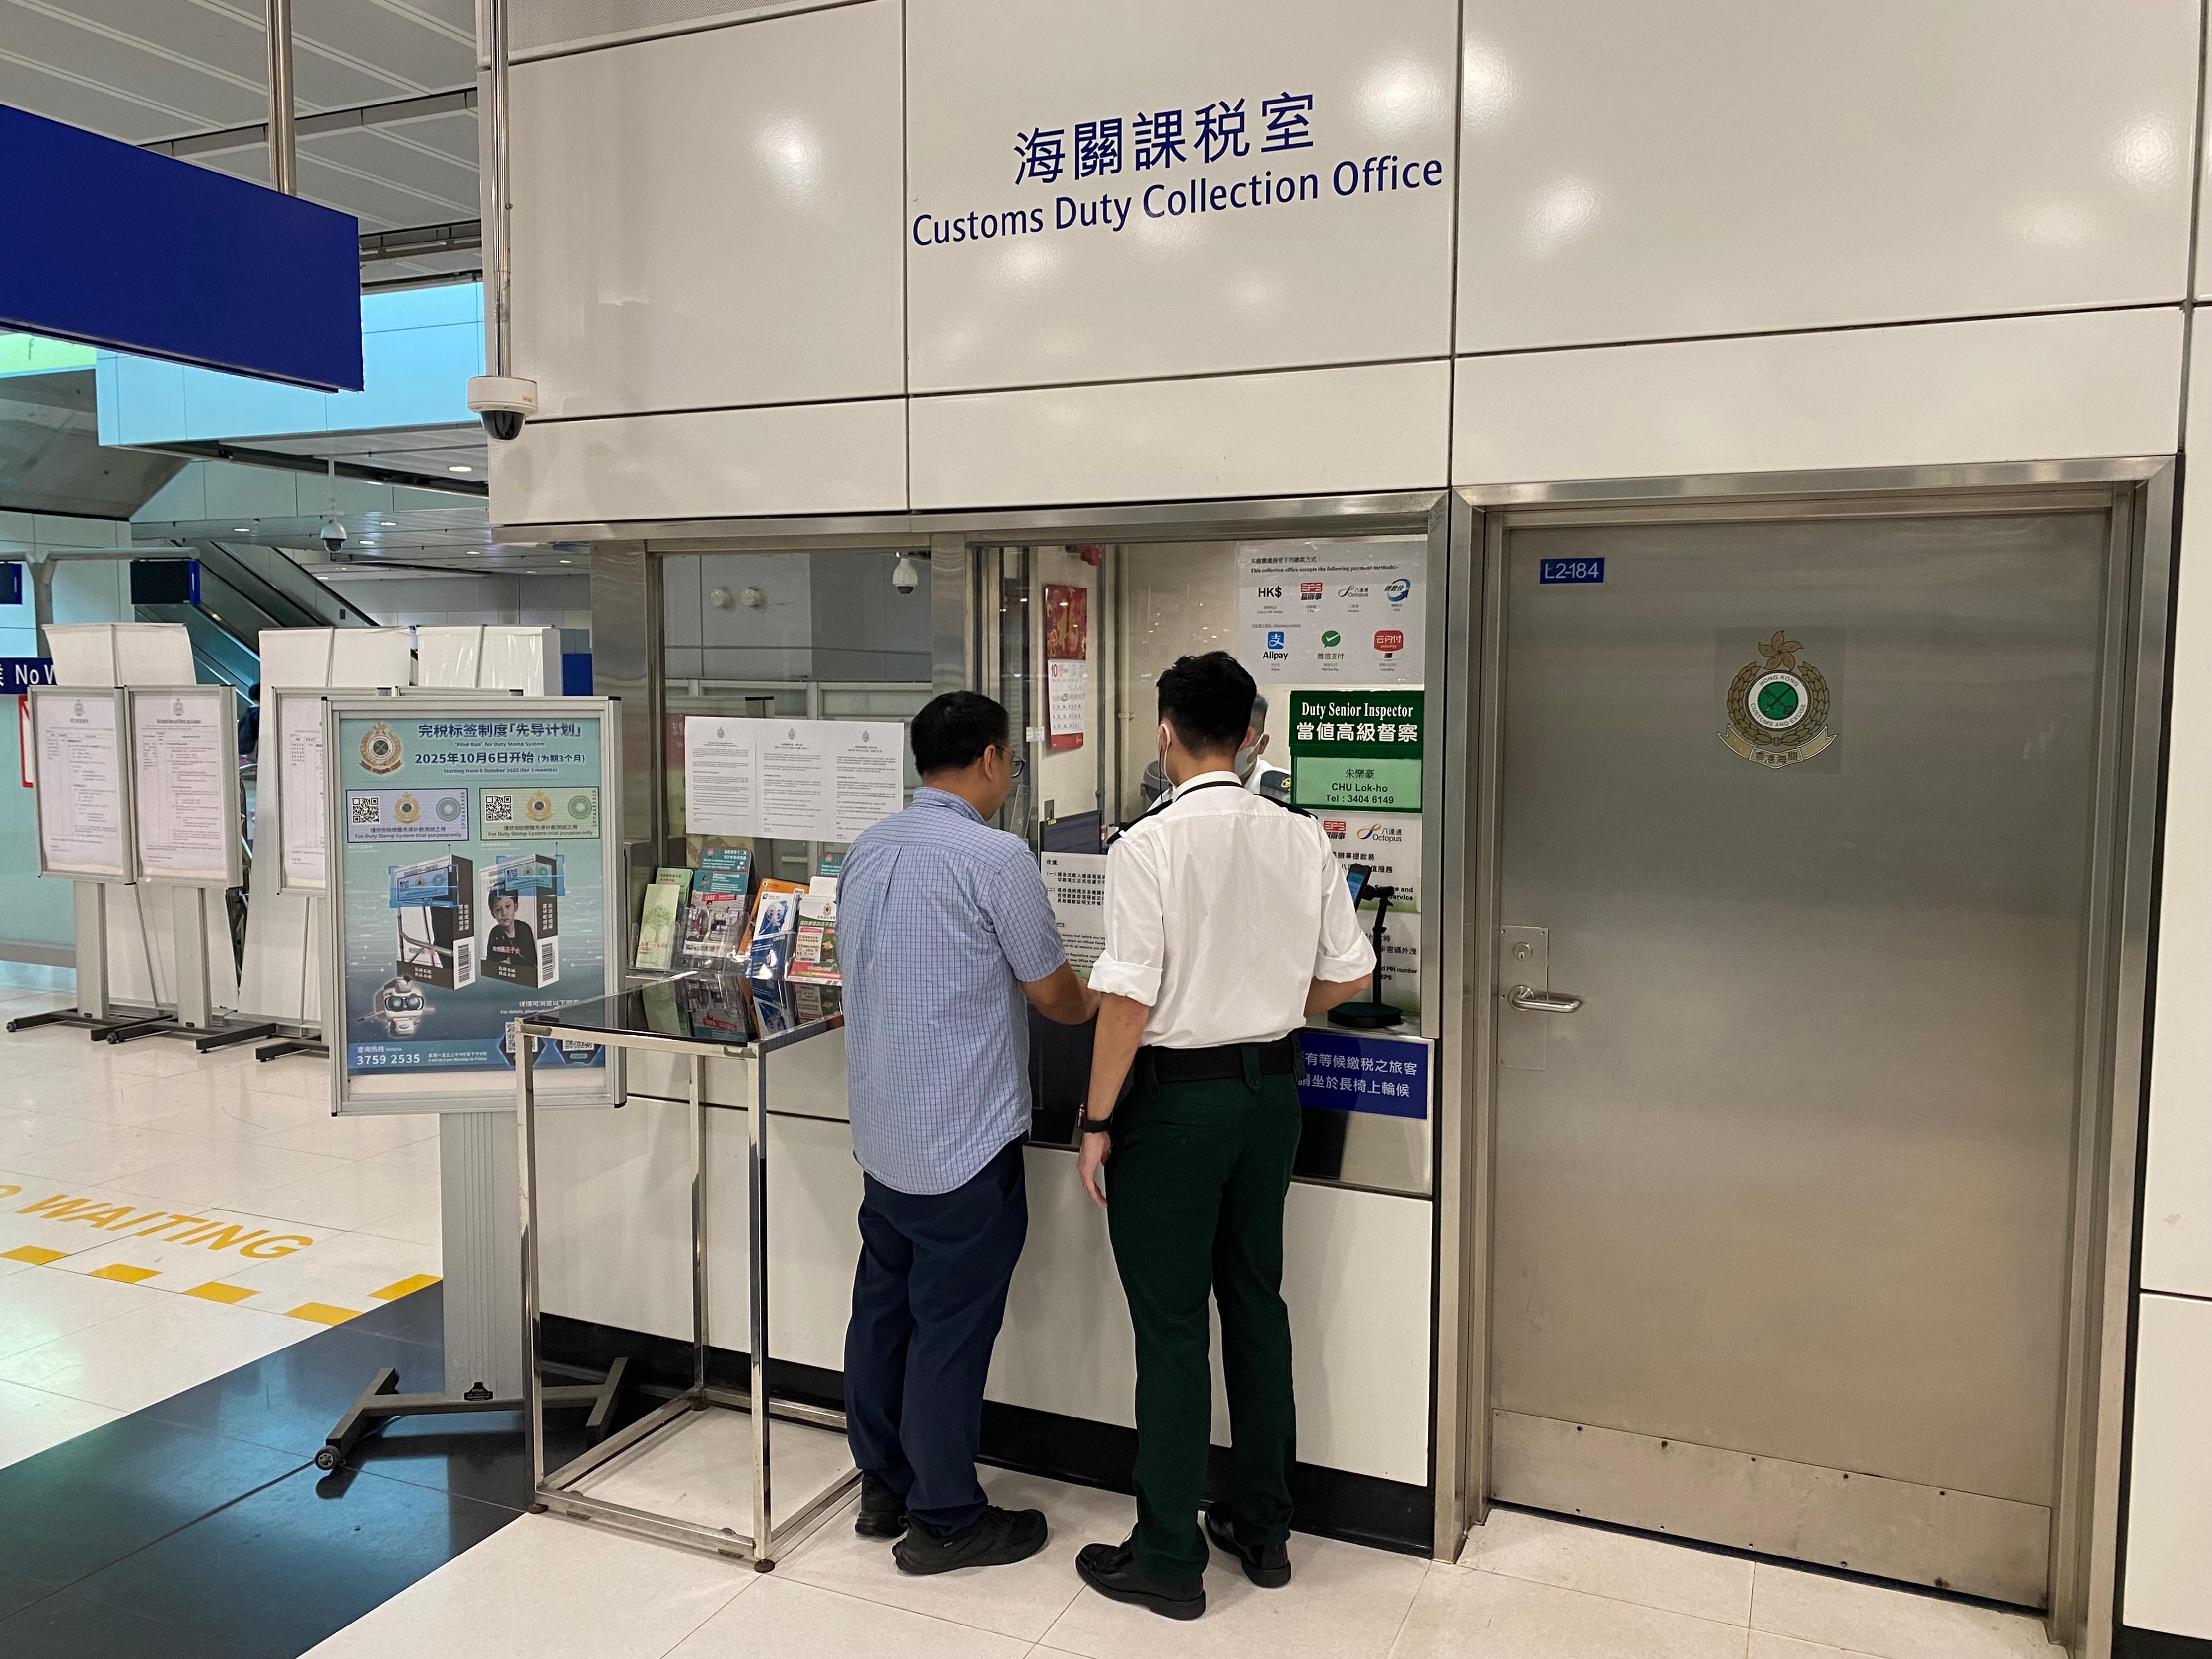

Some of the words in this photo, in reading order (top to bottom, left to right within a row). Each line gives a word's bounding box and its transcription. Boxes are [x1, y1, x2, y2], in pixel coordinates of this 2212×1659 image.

[912, 203, 1044, 247] Customs
[1055, 191, 1132, 233] Duty
[1142, 168, 1319, 221] Collection
[1333, 155, 1442, 197] Office
[1545, 562, 1599, 579] L2-184
[1258, 586, 1282, 598] HK$
[1263, 651, 1288, 660] Alipay
[15, 664, 39, 685] No
[1759, 675, 1778, 687] HONG
[1780, 675, 1799, 687] KONG
[1302, 702, 1326, 719] Duty
[1329, 702, 1361, 717] Senior
[1364, 703, 1413, 721] Inspector
[1750, 703, 1773, 727] CUSTOMS
[1791, 703, 1807, 724] EXCISE
[415, 751, 534, 765] 2025年10月6日开始
[1355, 783, 1387, 792] Lok-ho
[1326, 794, 1339, 802] Tel
[1324, 822, 1345, 830] EPS
[1372, 834, 1402, 842] Octopus
[357, 1055, 386, 1065] 3759
[391, 1054, 420, 1064] 2535
[1302, 1051, 1417, 1076] 有等候繳税之旅客
[15, 1194, 314, 1259] WAITING
